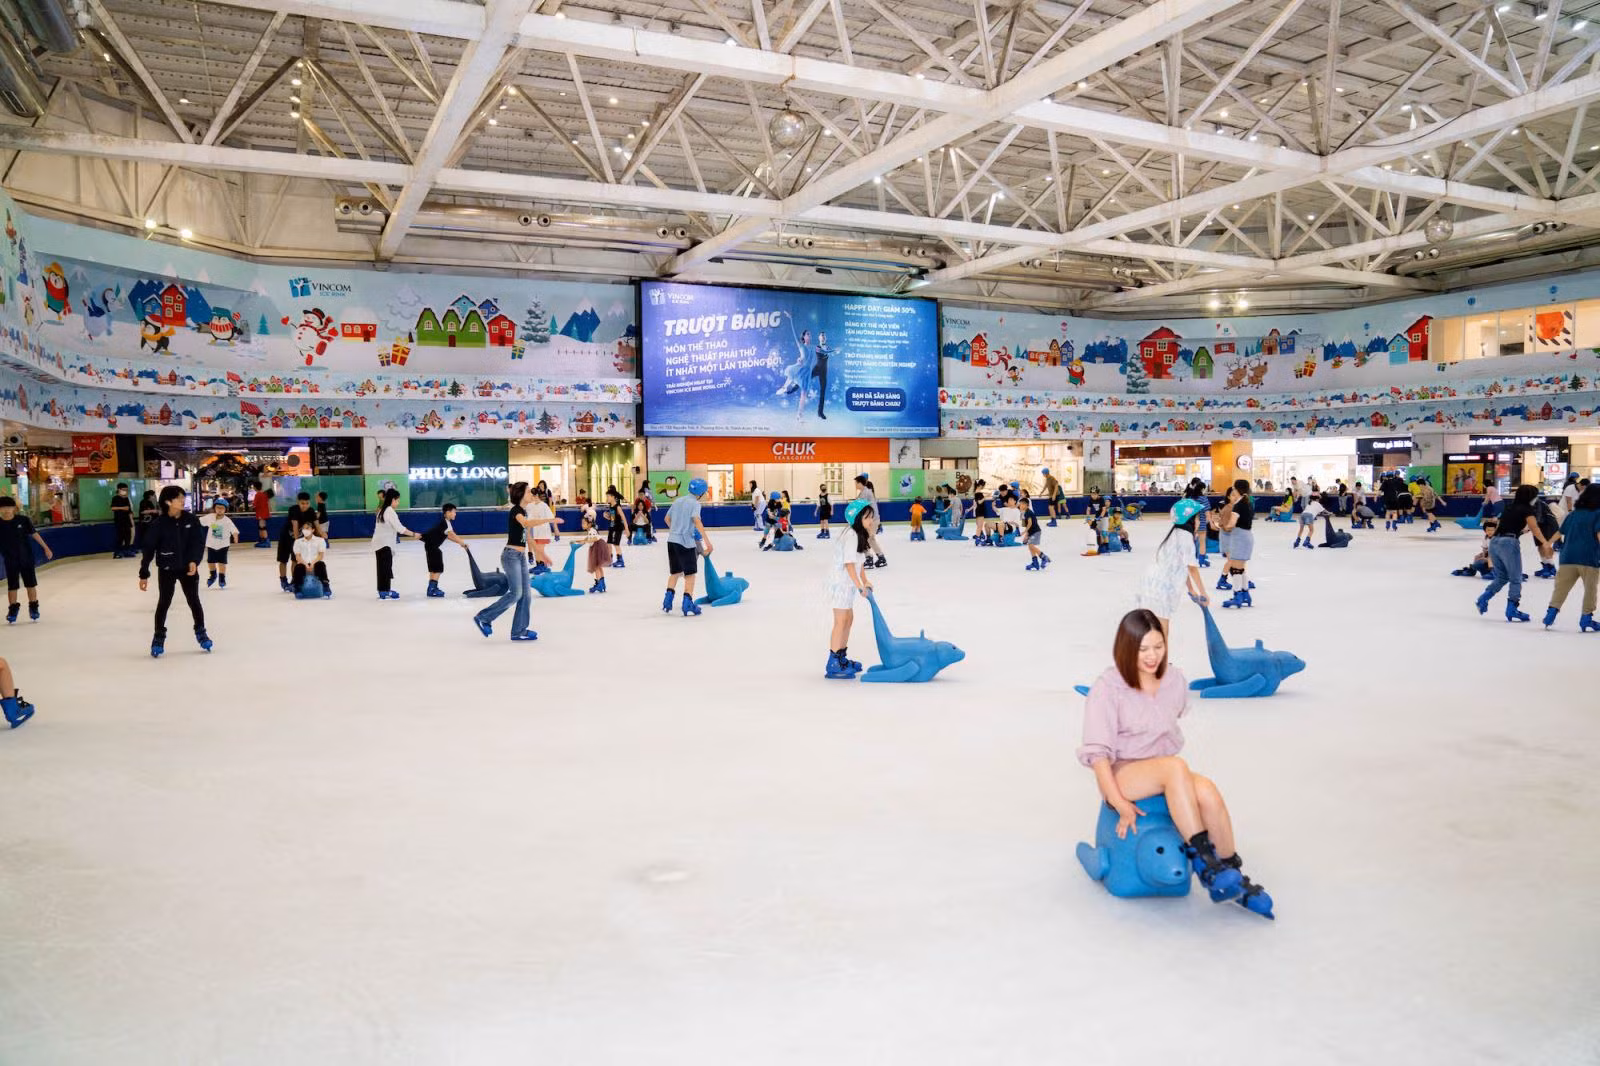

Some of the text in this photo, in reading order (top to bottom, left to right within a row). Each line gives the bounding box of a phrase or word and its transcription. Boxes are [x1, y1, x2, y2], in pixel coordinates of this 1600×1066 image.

[312, 283, 351, 292] VINCOM
[664, 308, 781, 337] TRƯỢT BĂNG
[666, 343, 686, 354] MÔN
[666, 354, 688, 366] NGHỆ
[666, 366, 674, 377] ÍT
[675, 364, 698, 376] NHẤT
[700, 360, 718, 374] MỘT
[772, 442, 816, 455] CHUK
[409, 466, 508, 480] PHUC LONG
